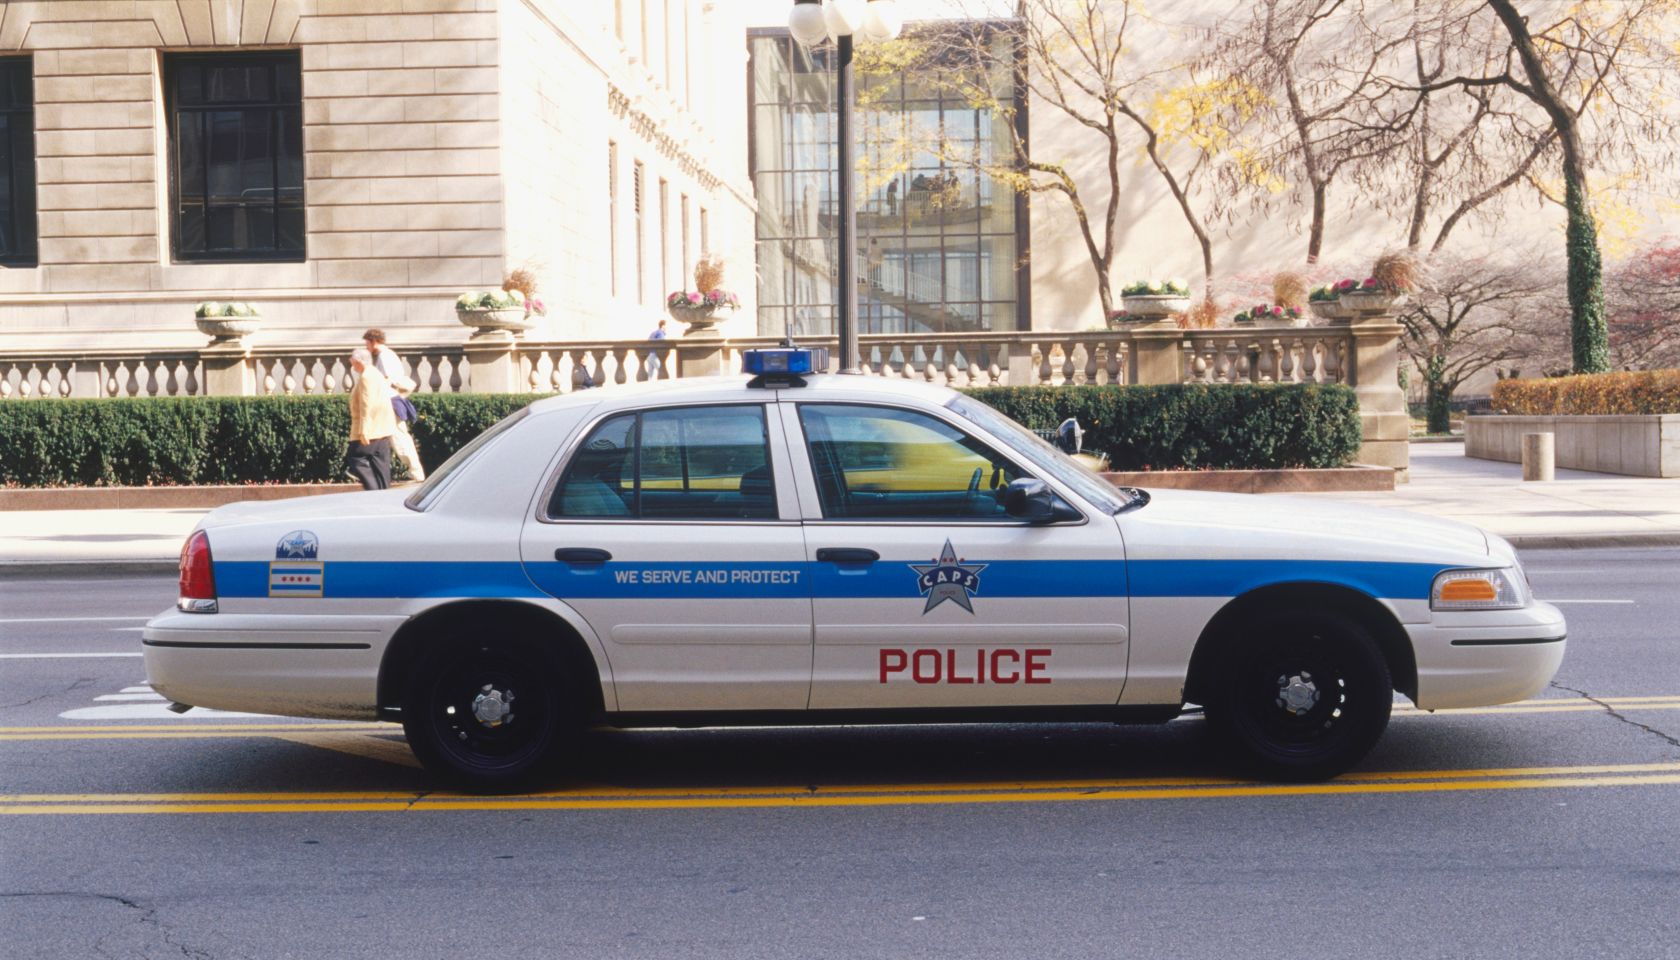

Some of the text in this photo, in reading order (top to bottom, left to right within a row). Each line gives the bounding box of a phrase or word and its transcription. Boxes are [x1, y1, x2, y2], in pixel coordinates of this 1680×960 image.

[615, 570, 800, 583] WE SERVE AND PROTECT
[923, 570, 974, 586] CAPS
[879, 649, 1052, 684] POLICE
